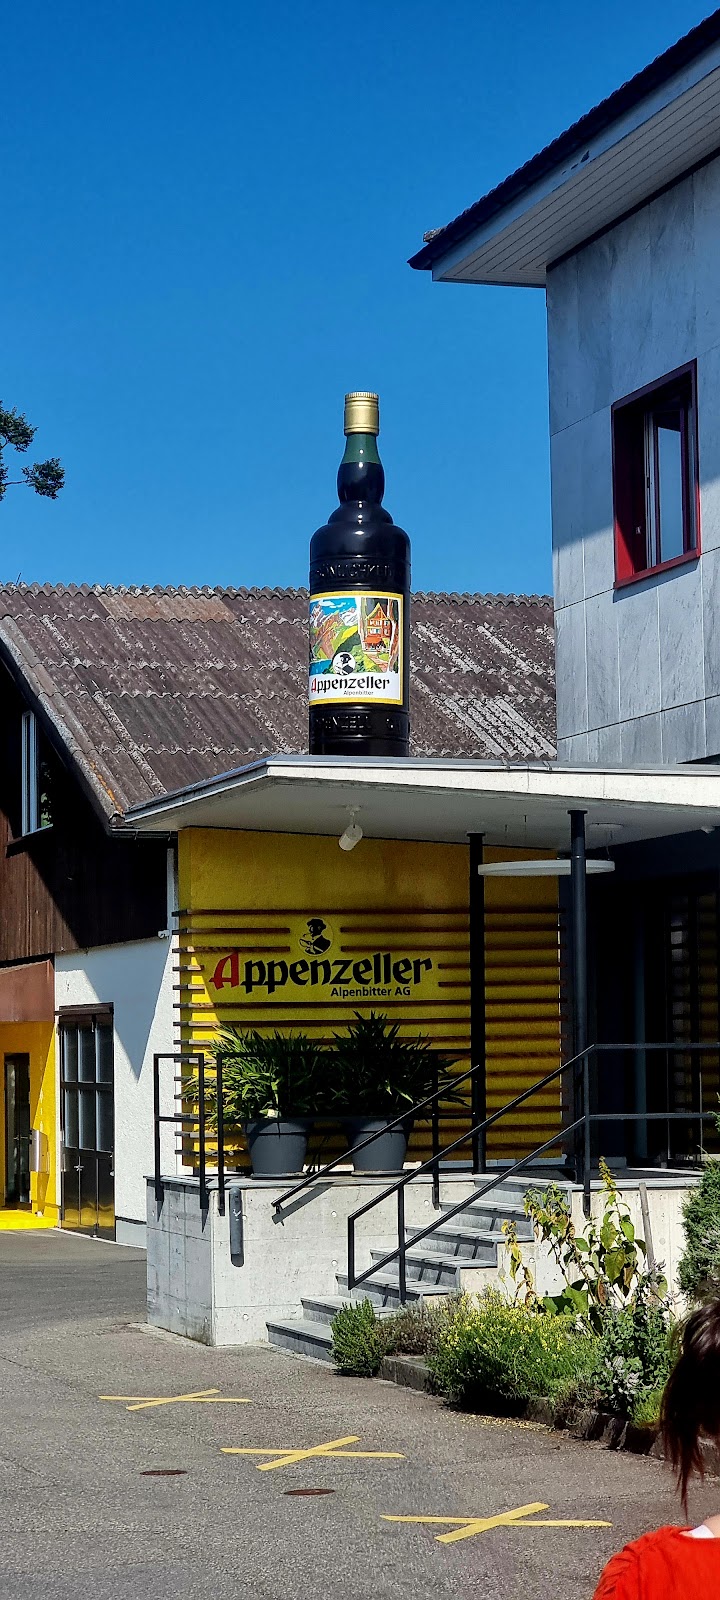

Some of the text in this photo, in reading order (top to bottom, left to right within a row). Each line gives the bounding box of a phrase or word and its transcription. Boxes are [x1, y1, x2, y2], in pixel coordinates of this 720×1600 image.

[311, 676, 390, 694] Appenzeller
[208, 951, 433, 995] Appenzeller
[330, 986, 411, 999] Alpenbitter AG
